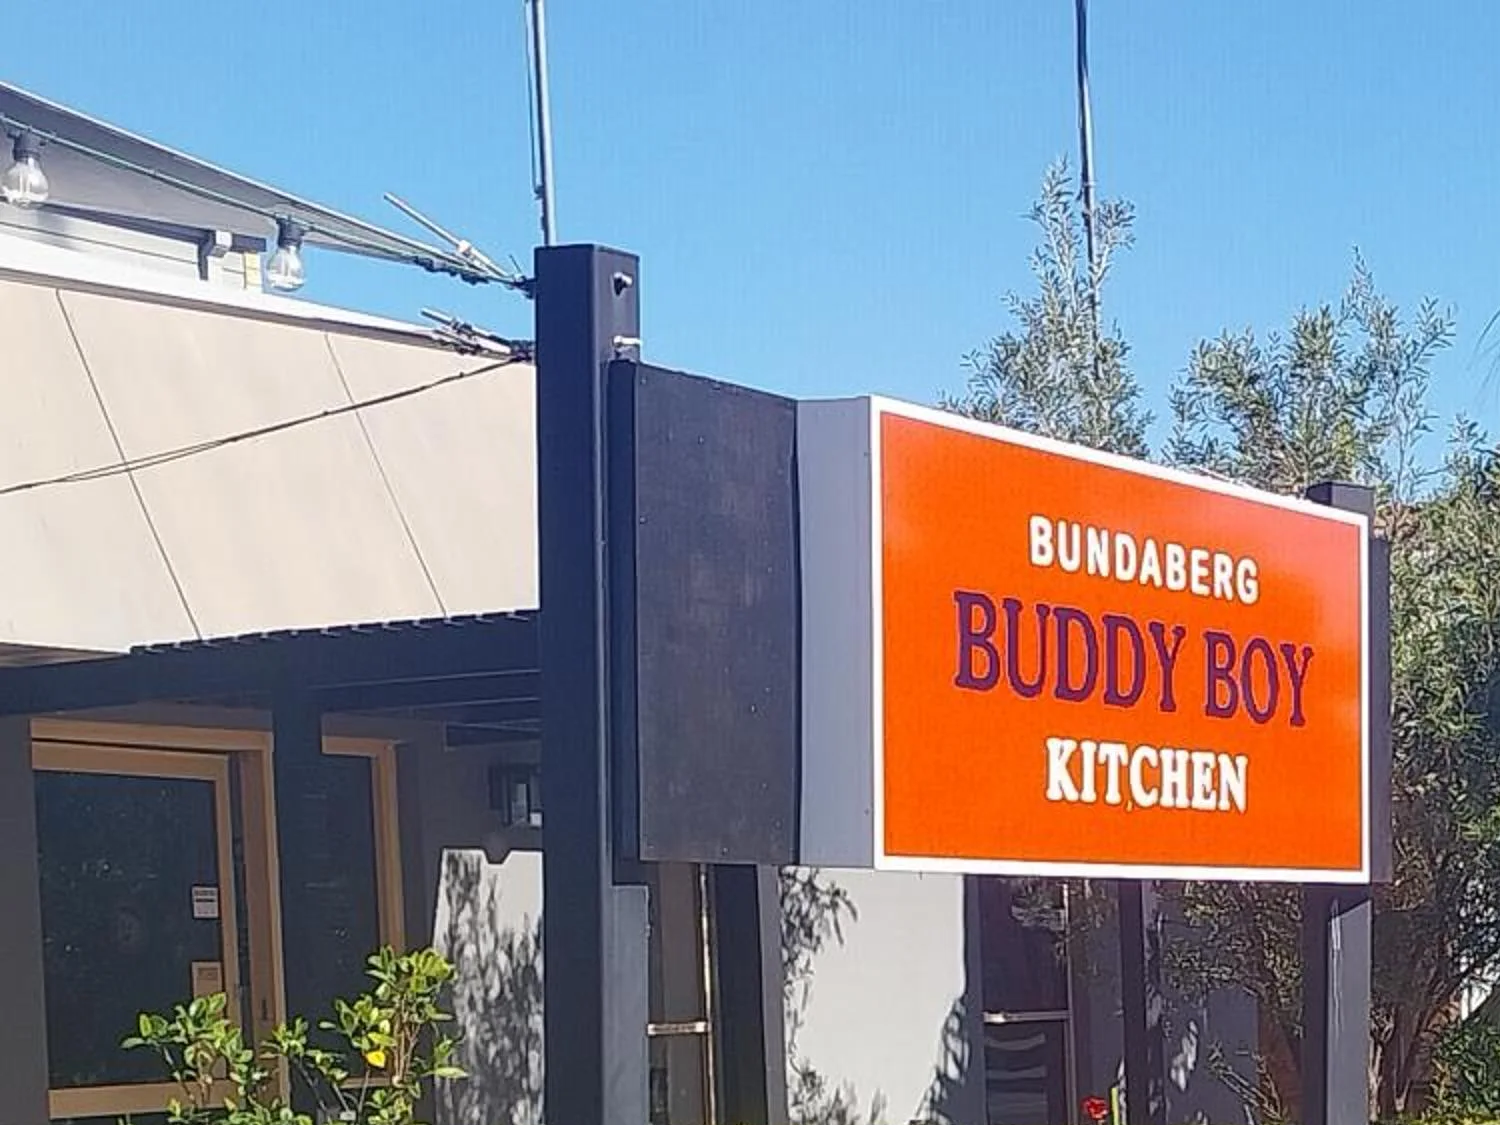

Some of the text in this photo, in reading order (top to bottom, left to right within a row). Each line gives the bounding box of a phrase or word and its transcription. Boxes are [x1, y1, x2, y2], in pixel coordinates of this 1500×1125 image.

[1028, 514, 1260, 604] BUNDABERG
[953, 590, 1315, 727] BUDDY BOY
[1045, 736, 1249, 812] KITCHEN
